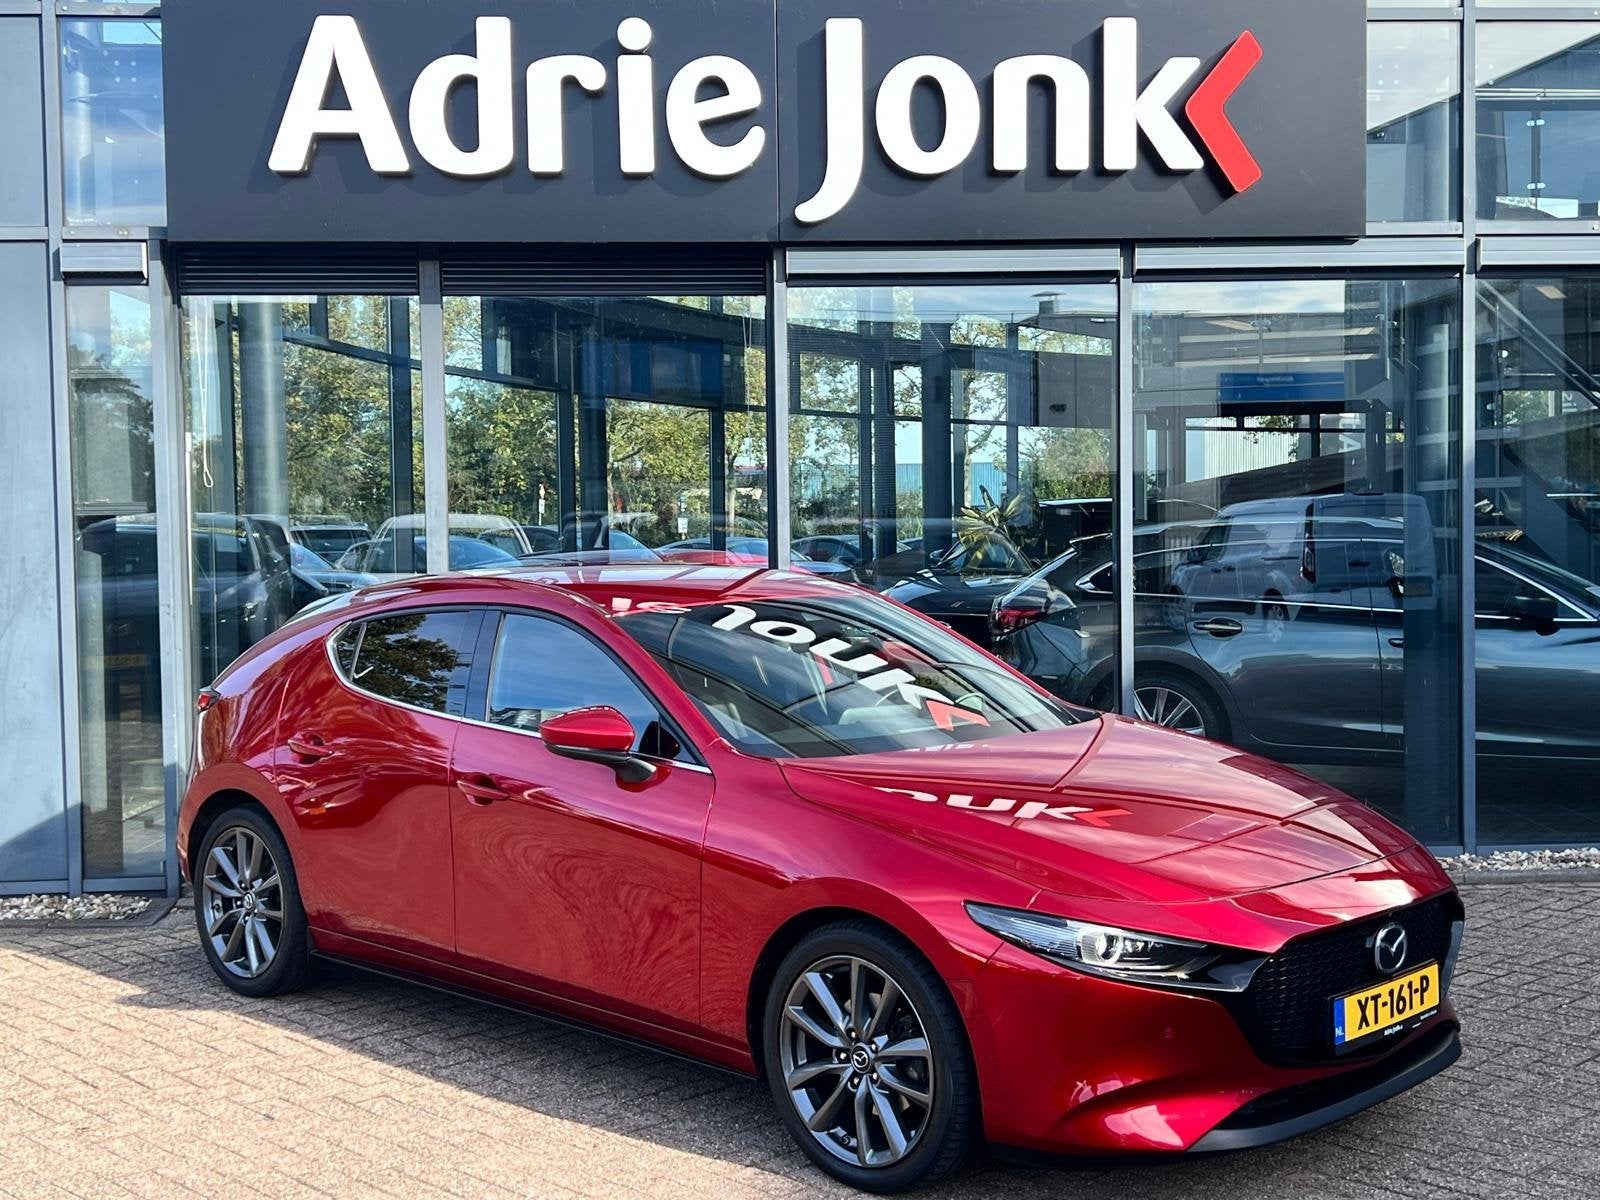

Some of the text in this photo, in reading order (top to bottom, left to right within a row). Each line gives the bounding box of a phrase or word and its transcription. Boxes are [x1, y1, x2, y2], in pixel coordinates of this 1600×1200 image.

[268, 15, 1204, 224] Adrie Jonk
[1357, 975, 1430, 1030] XT-161-P
[1335, 1026, 1344, 1037] NL
